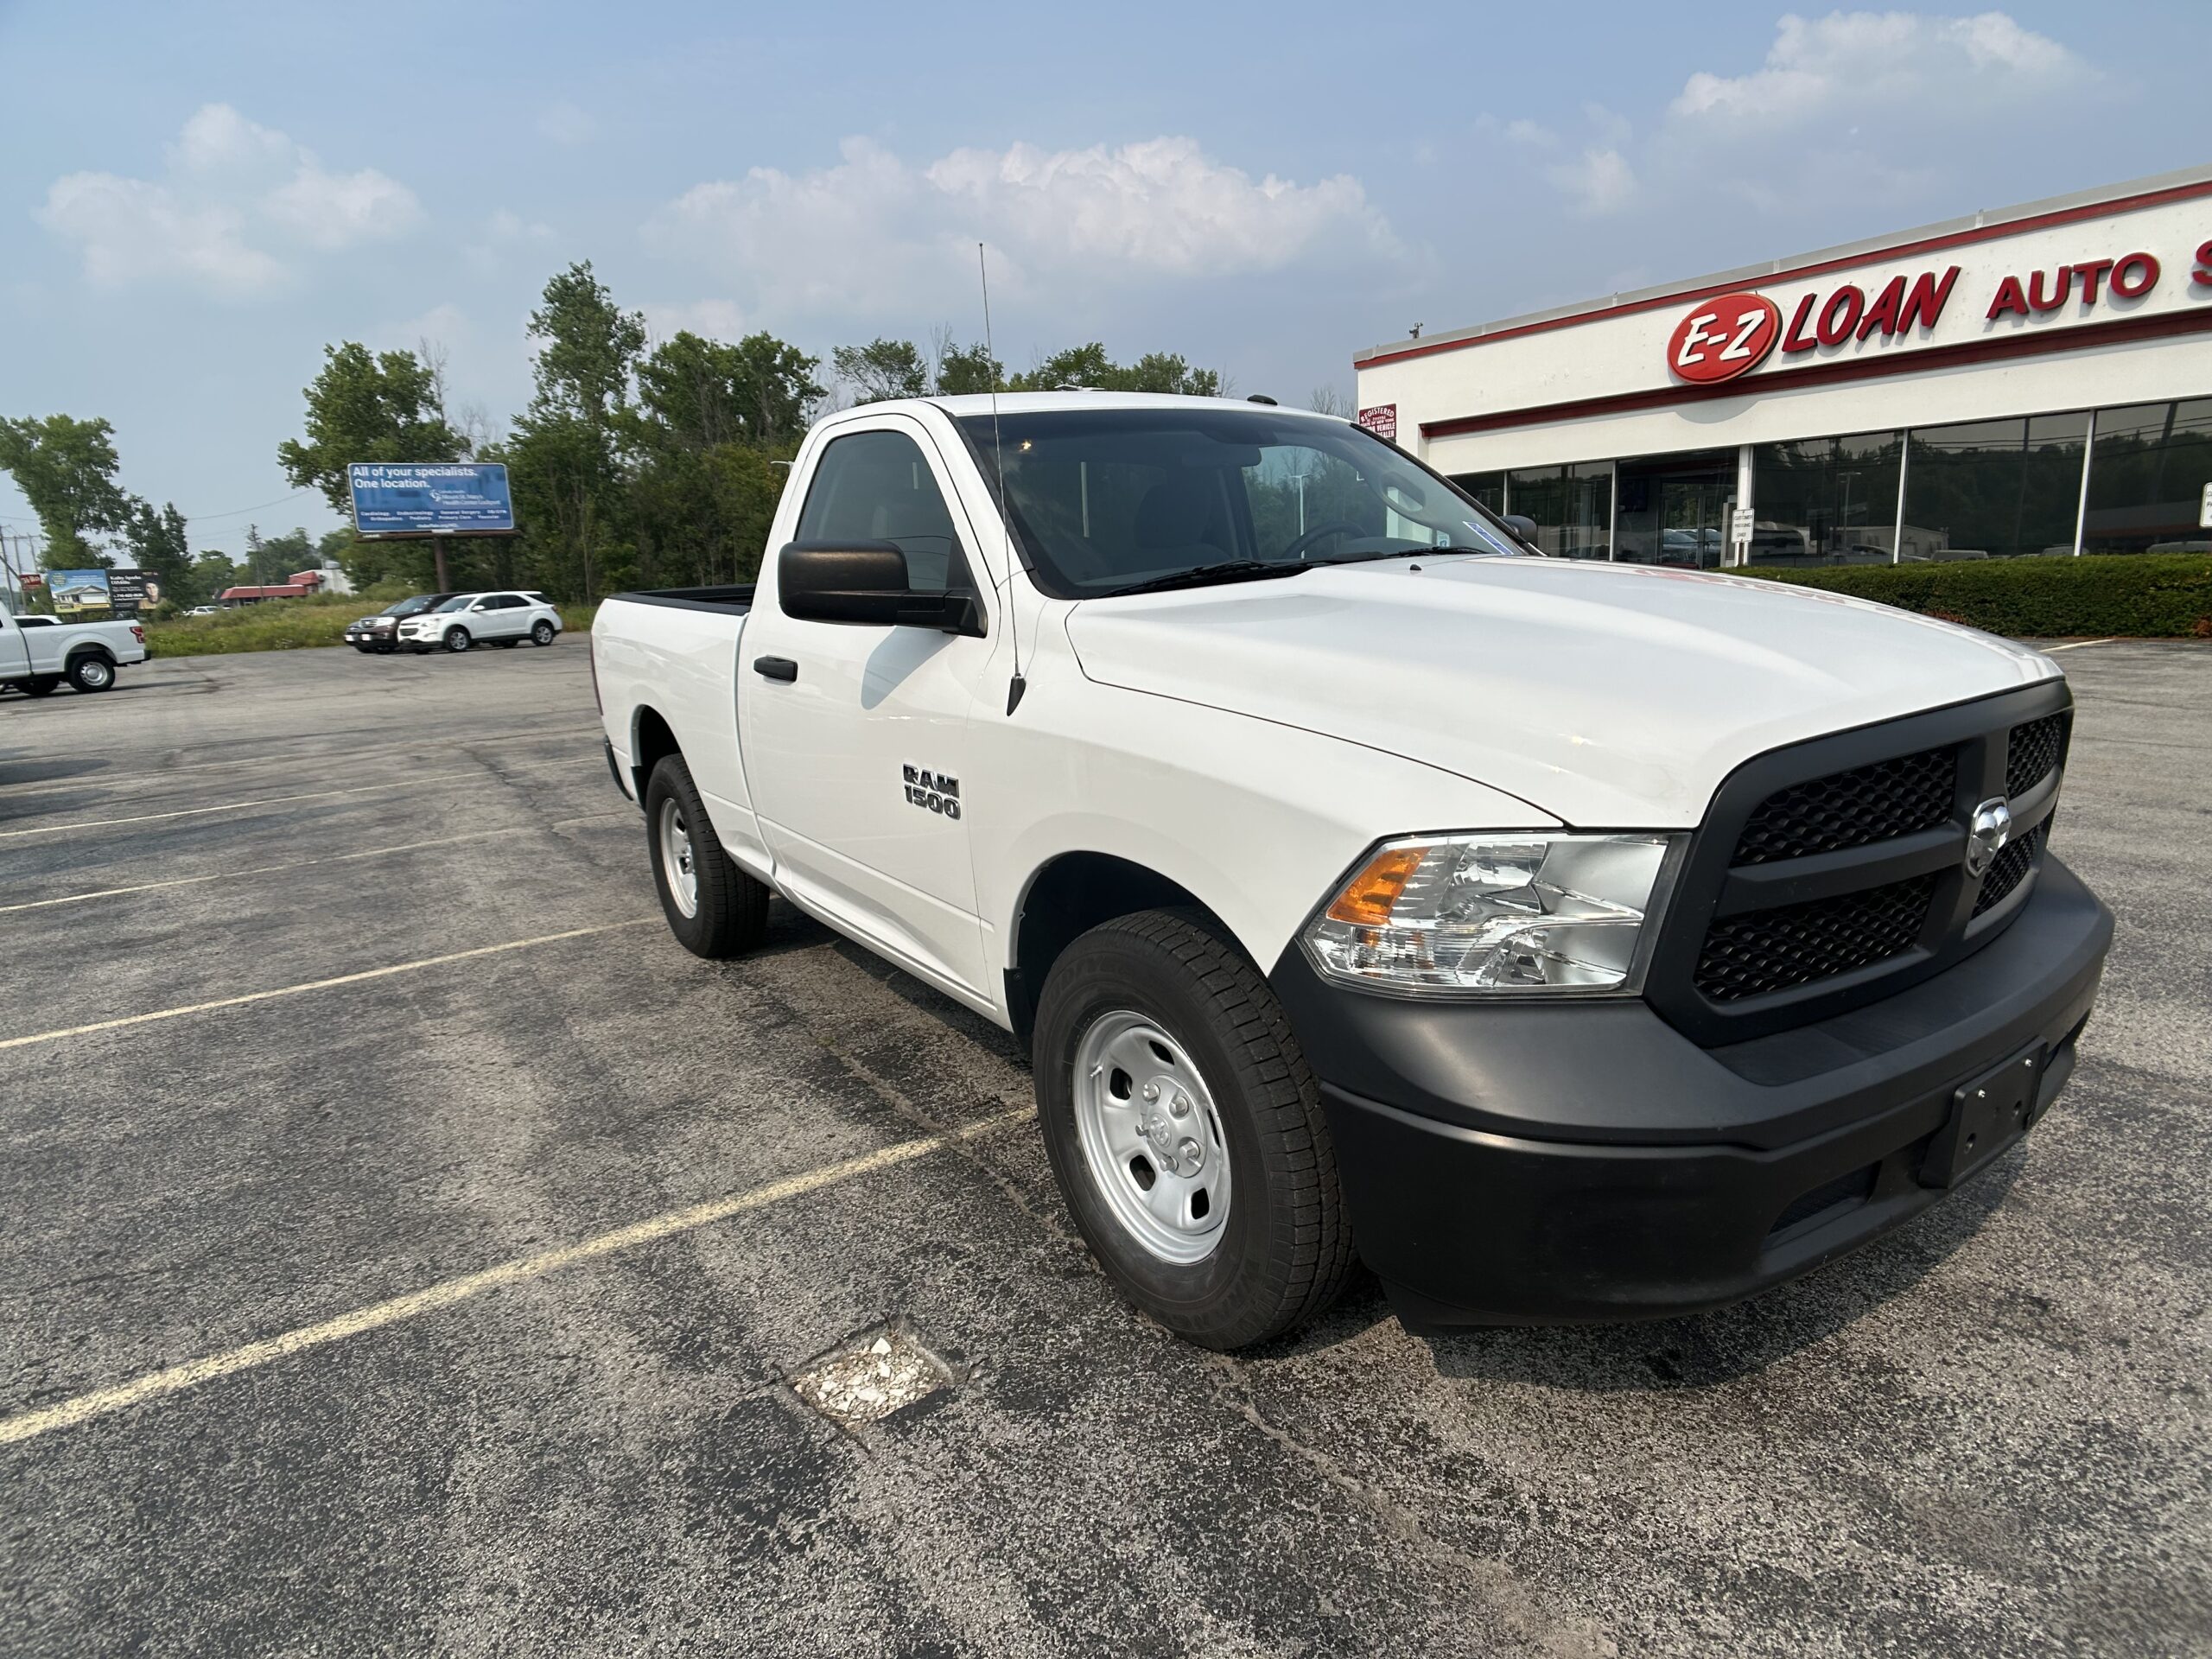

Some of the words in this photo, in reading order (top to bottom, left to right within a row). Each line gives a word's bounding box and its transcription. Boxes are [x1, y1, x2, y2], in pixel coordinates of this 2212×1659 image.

[1677, 308, 1766, 367] E-Z
[1781, 265, 1961, 353] LOAN
[1986, 251, 2161, 320] AUTO
[1360, 407, 1395, 423] REGISTERED
[1376, 423, 1395, 432] VEHICLE
[353, 467, 369, 476] All
[372, 467, 385, 476] of
[386, 468, 412, 478] your
[415, 467, 478, 478] specialists.
[354, 478, 378, 488] One
[380, 478, 430, 488] location.
[903, 763, 960, 799] RAM
[904, 784, 962, 821] 1500
